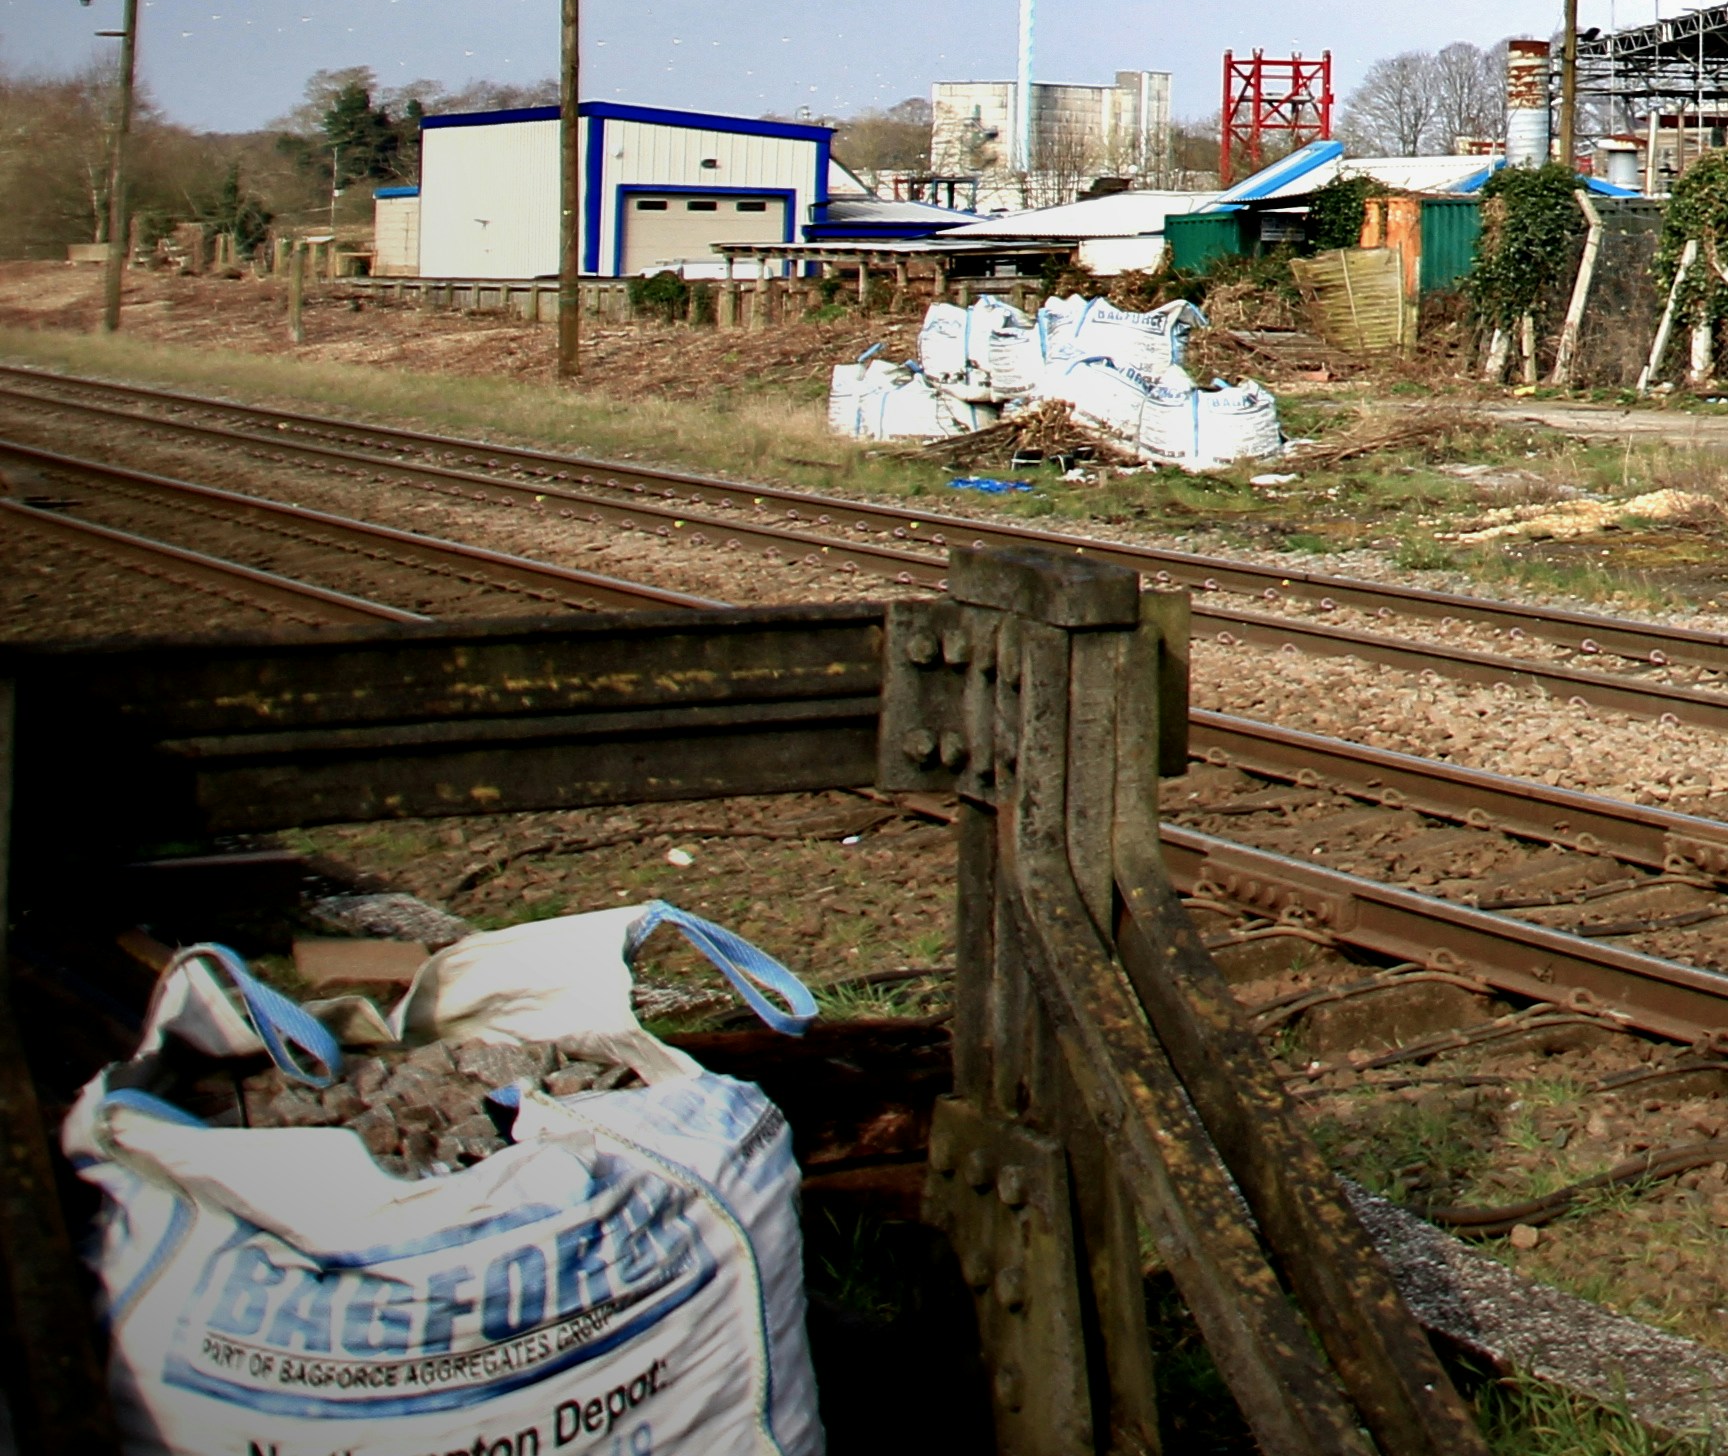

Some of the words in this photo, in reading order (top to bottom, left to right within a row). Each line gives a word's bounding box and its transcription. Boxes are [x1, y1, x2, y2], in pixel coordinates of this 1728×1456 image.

[203, 1337, 246, 1369] PART
[249, 1352, 274, 1379] OF
[279, 1359, 399, 1389] BAGFORCE
[404, 1333, 552, 1385] AGGREGATES
